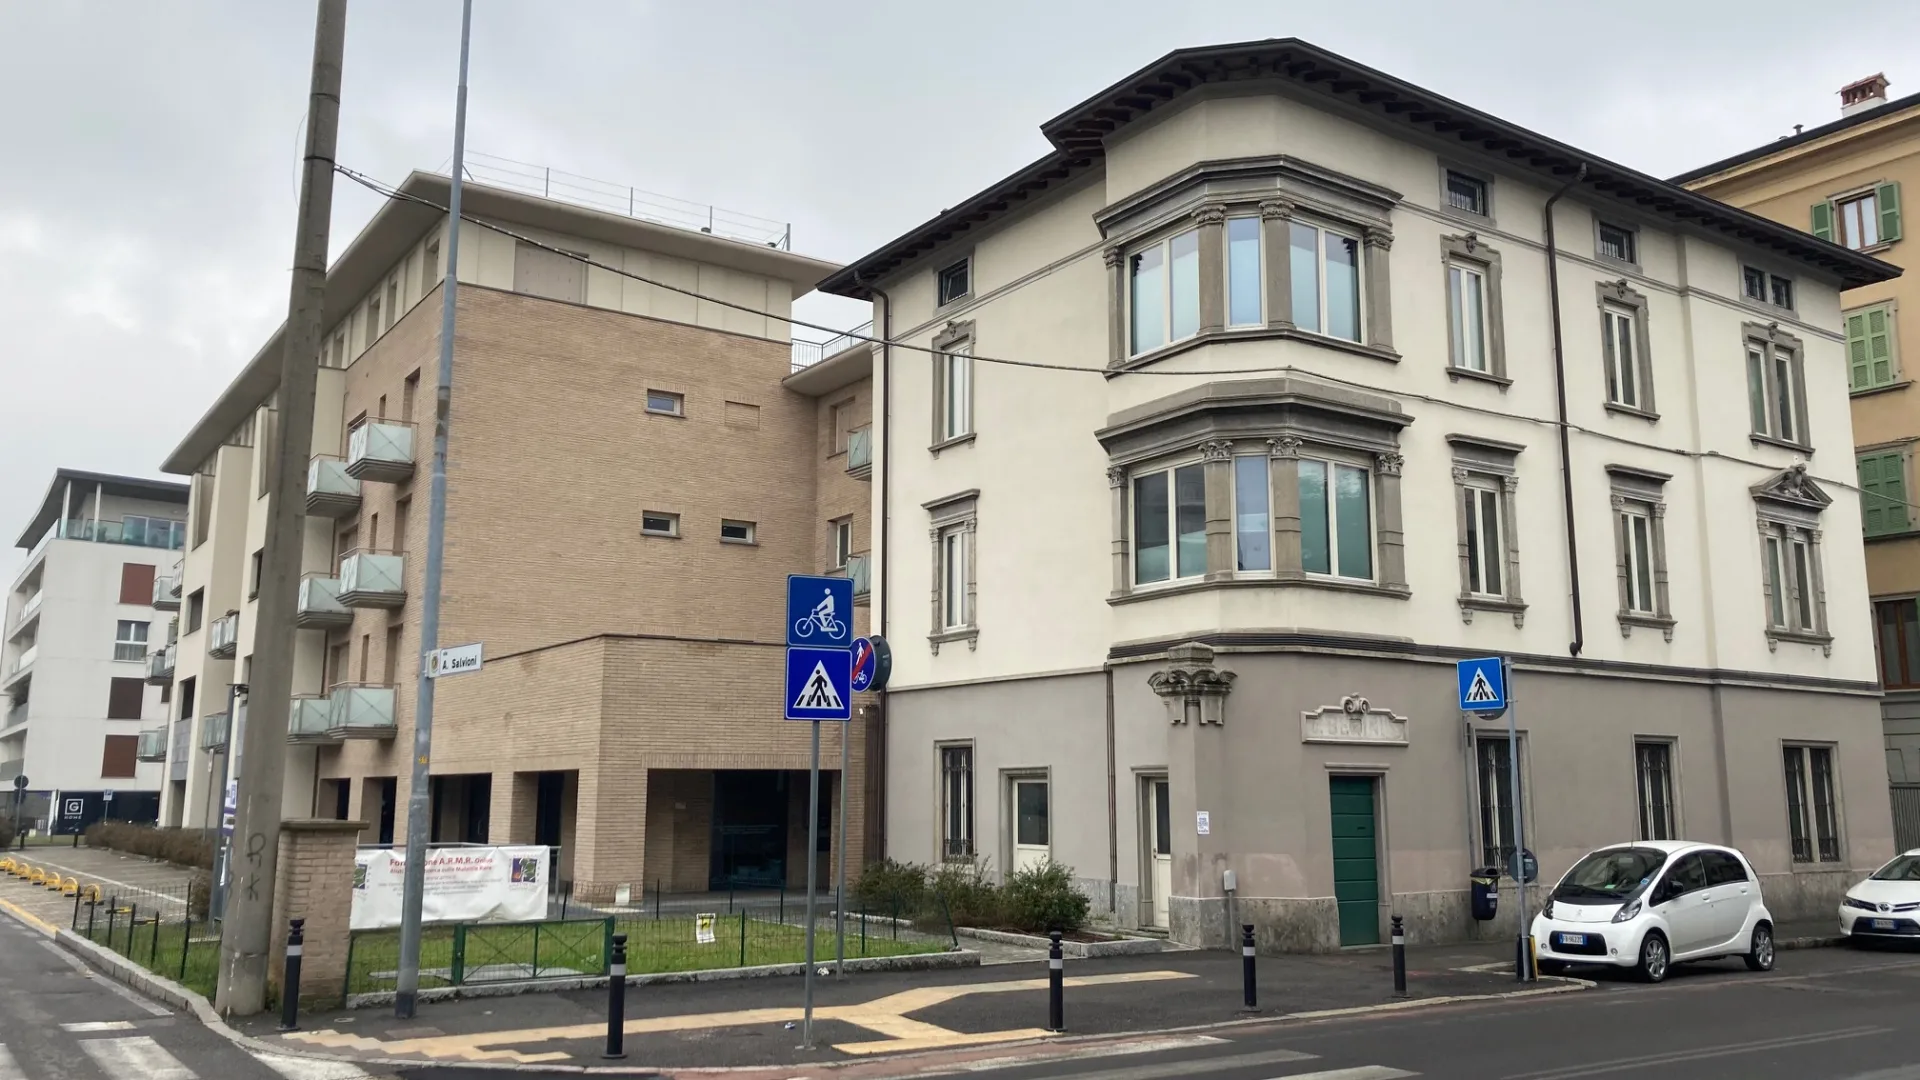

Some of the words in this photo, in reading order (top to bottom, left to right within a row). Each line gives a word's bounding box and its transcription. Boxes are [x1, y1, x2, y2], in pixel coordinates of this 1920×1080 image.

[442, 660, 449, 670] A.
[452, 655, 477, 669] Salvioni
[69, 802, 79, 812] G
